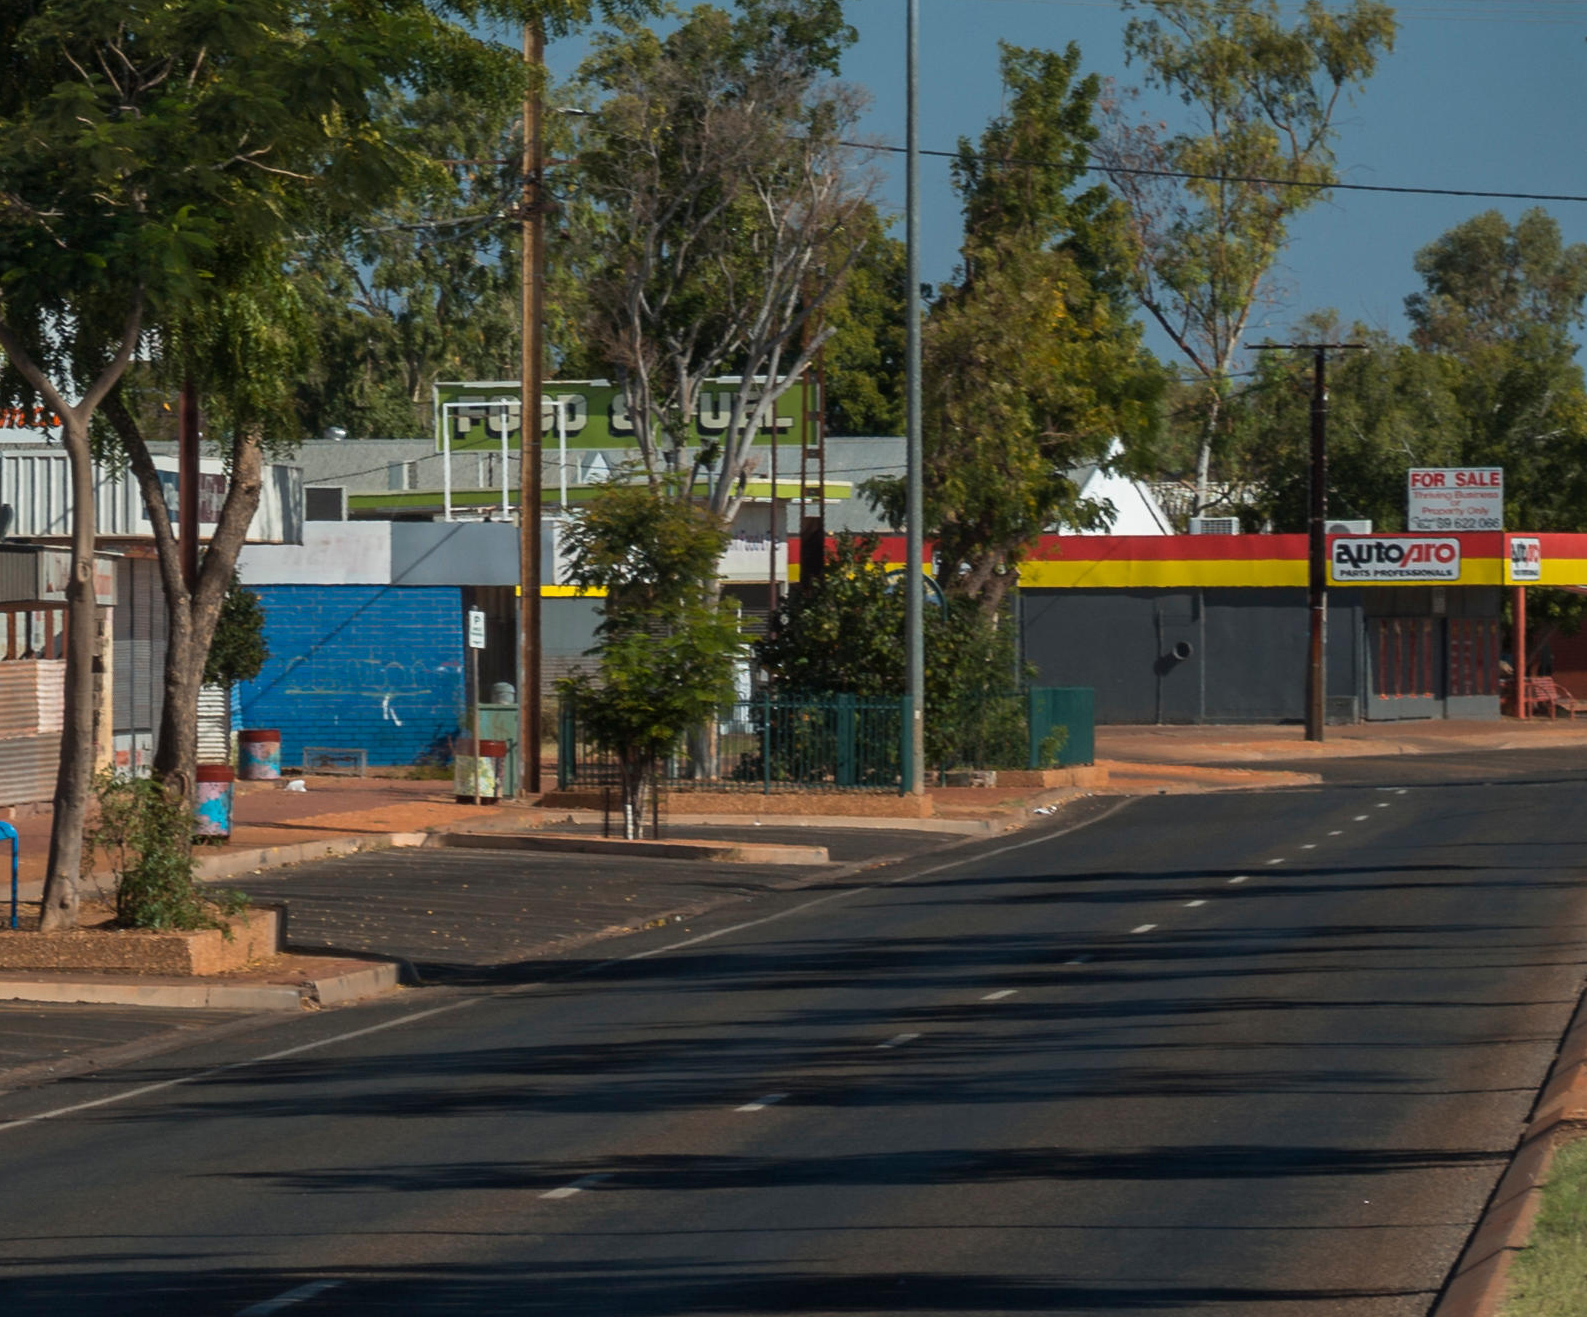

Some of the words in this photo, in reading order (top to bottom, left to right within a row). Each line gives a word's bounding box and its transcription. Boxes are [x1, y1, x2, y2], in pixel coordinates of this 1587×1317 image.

[698, 392, 794, 430] UEL
[1411, 473, 1446, 487] FOR
[1455, 472, 1501, 487] SALE
[1454, 490, 1499, 499] Business
[1340, 569, 1371, 578] PARTS
[1373, 569, 1453, 578] PROFESSIONALS
